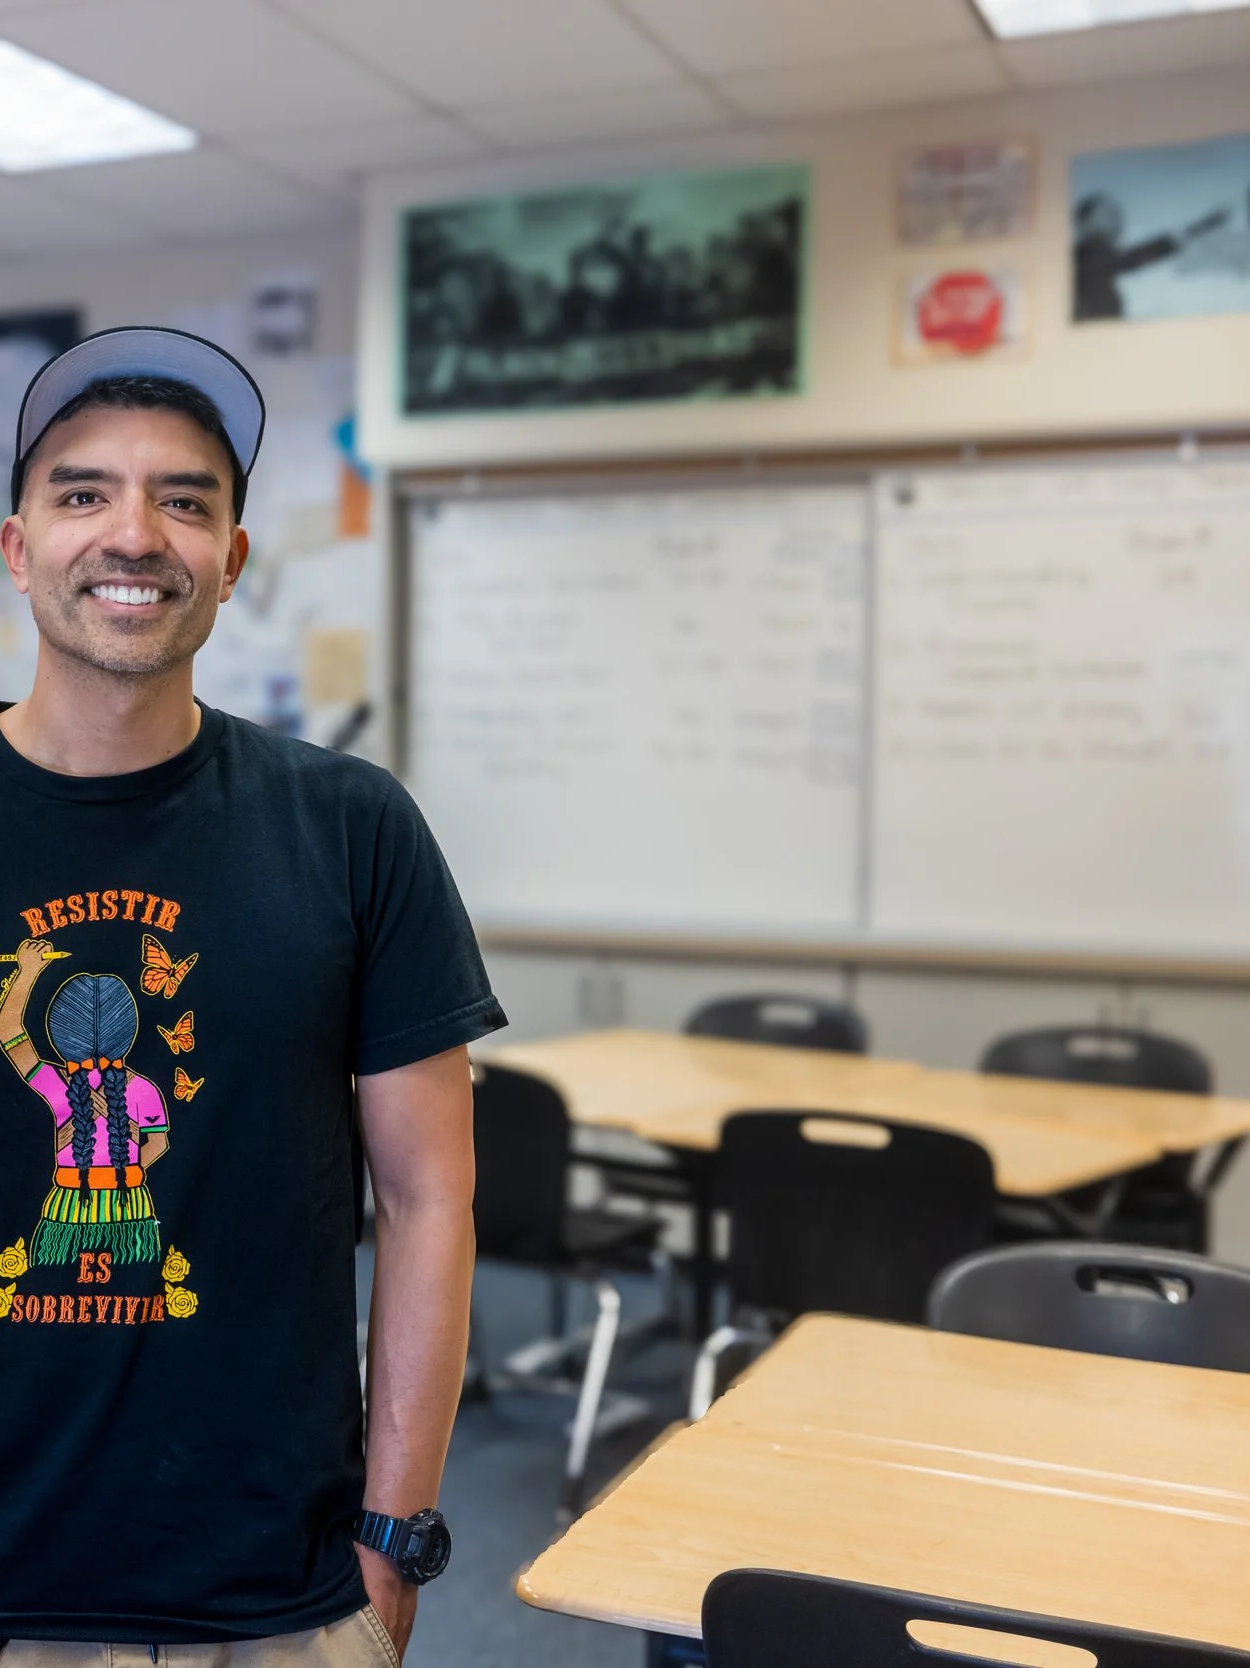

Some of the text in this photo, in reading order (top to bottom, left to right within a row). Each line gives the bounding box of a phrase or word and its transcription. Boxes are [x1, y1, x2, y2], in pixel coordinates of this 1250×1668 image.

[20, 889, 181, 938] RESISTIR
[77, 1252, 112, 1284] ES
[11, 1294, 165, 1325] SOBREVIVIR
